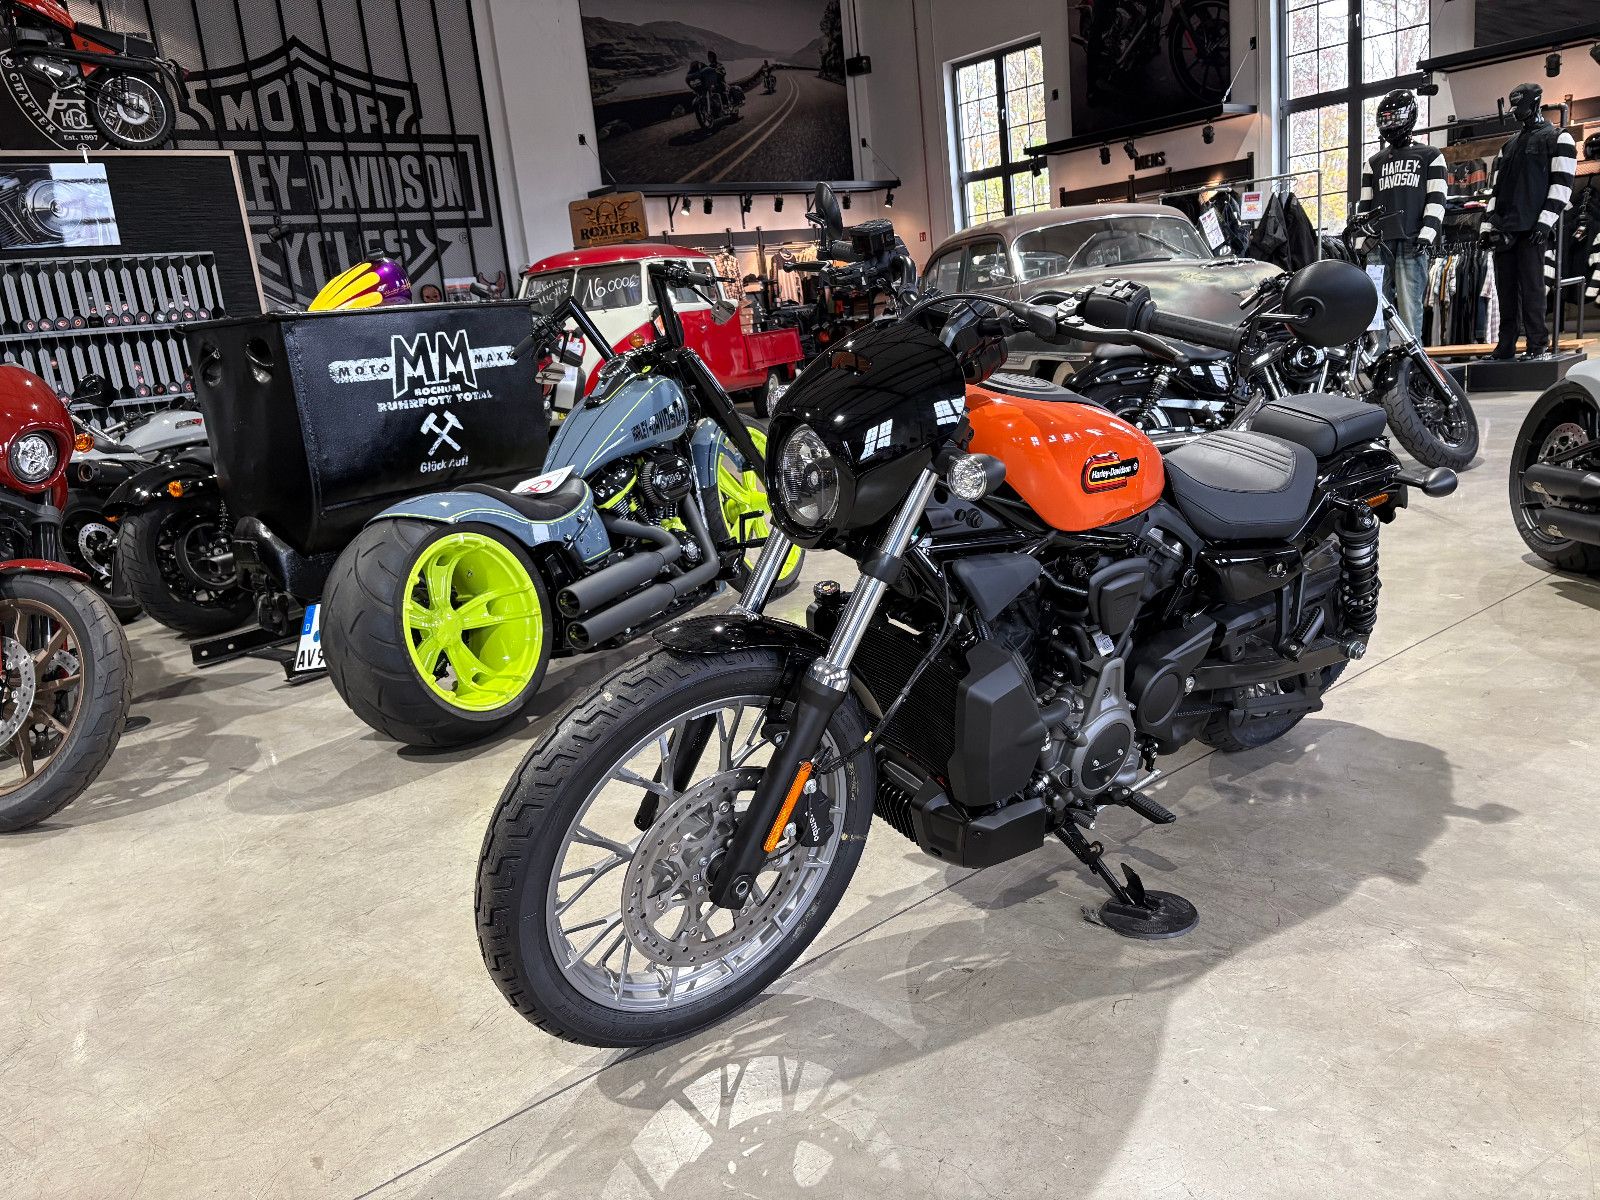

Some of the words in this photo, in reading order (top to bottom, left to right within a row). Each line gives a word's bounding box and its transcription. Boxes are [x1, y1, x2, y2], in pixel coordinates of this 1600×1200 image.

[9, 72, 56, 134] CHAPTER
[414, 384, 461, 396] BOCHUM
[420, 459, 446, 473] Glück
[1091, 465, 1131, 480] Harley-Davidson
